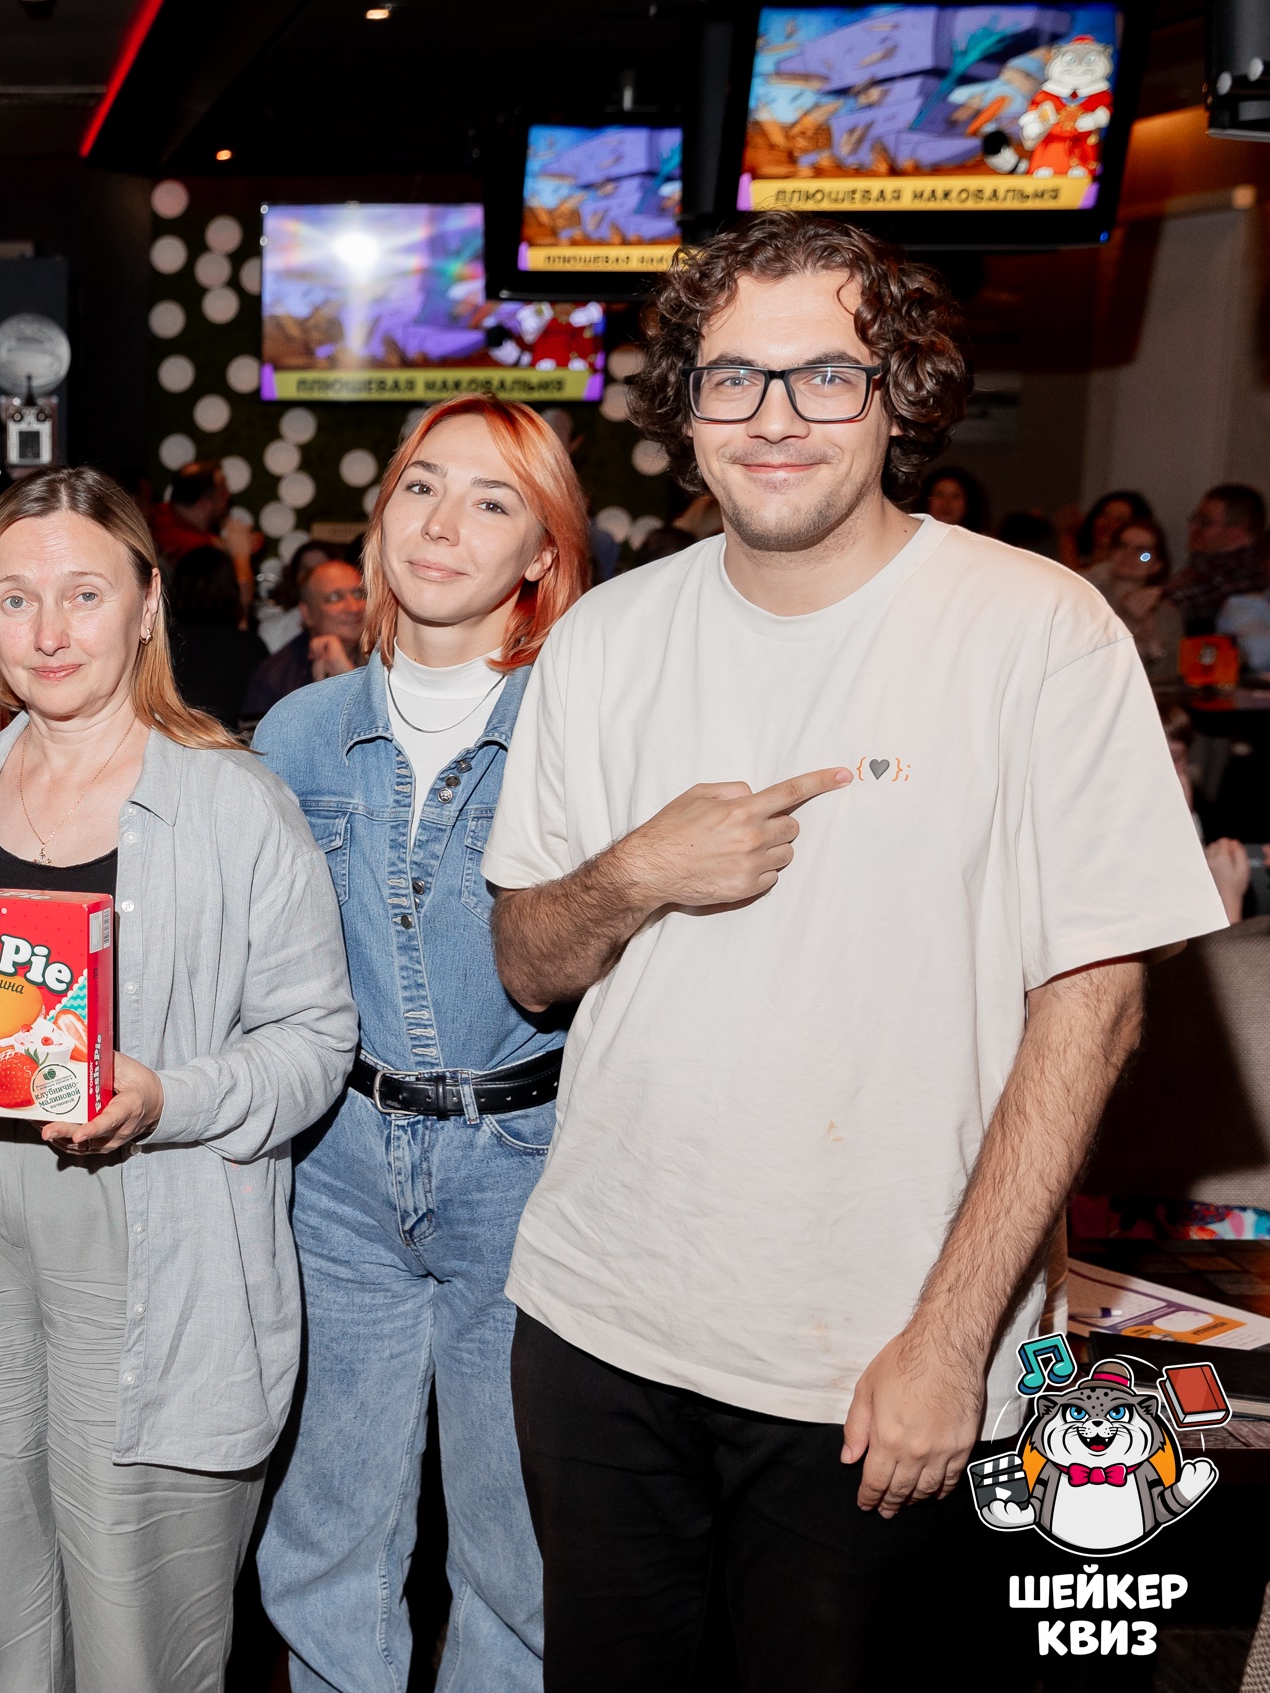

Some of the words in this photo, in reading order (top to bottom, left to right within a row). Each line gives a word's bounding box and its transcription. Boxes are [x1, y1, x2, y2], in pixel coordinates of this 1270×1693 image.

[773, 188, 902, 205] ПЛЮШЕВАЯ
[912, 187, 1061, 203] НАКОВАЛЬНЯ
[295, 378, 417, 393] ПЛЮШЕВАЯ
[423, 377, 565, 393] НАКОВАЛЬНЯ
[38, 1087, 82, 1108] малиновой
